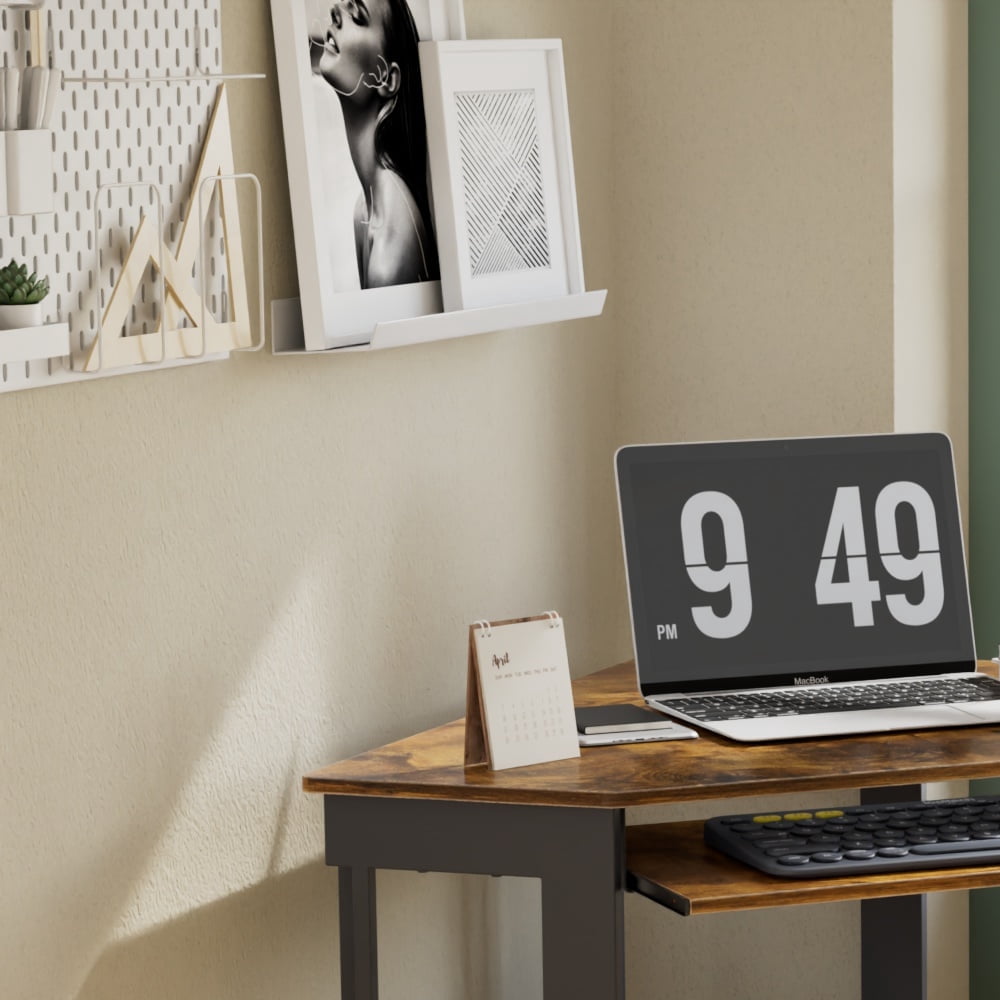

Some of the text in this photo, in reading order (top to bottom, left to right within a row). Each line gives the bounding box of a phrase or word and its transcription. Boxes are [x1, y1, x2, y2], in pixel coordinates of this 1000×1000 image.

[680, 480, 944, 639] 9 49
[656, 624, 678, 641] PM
[793, 675, 829, 686] MacBook
